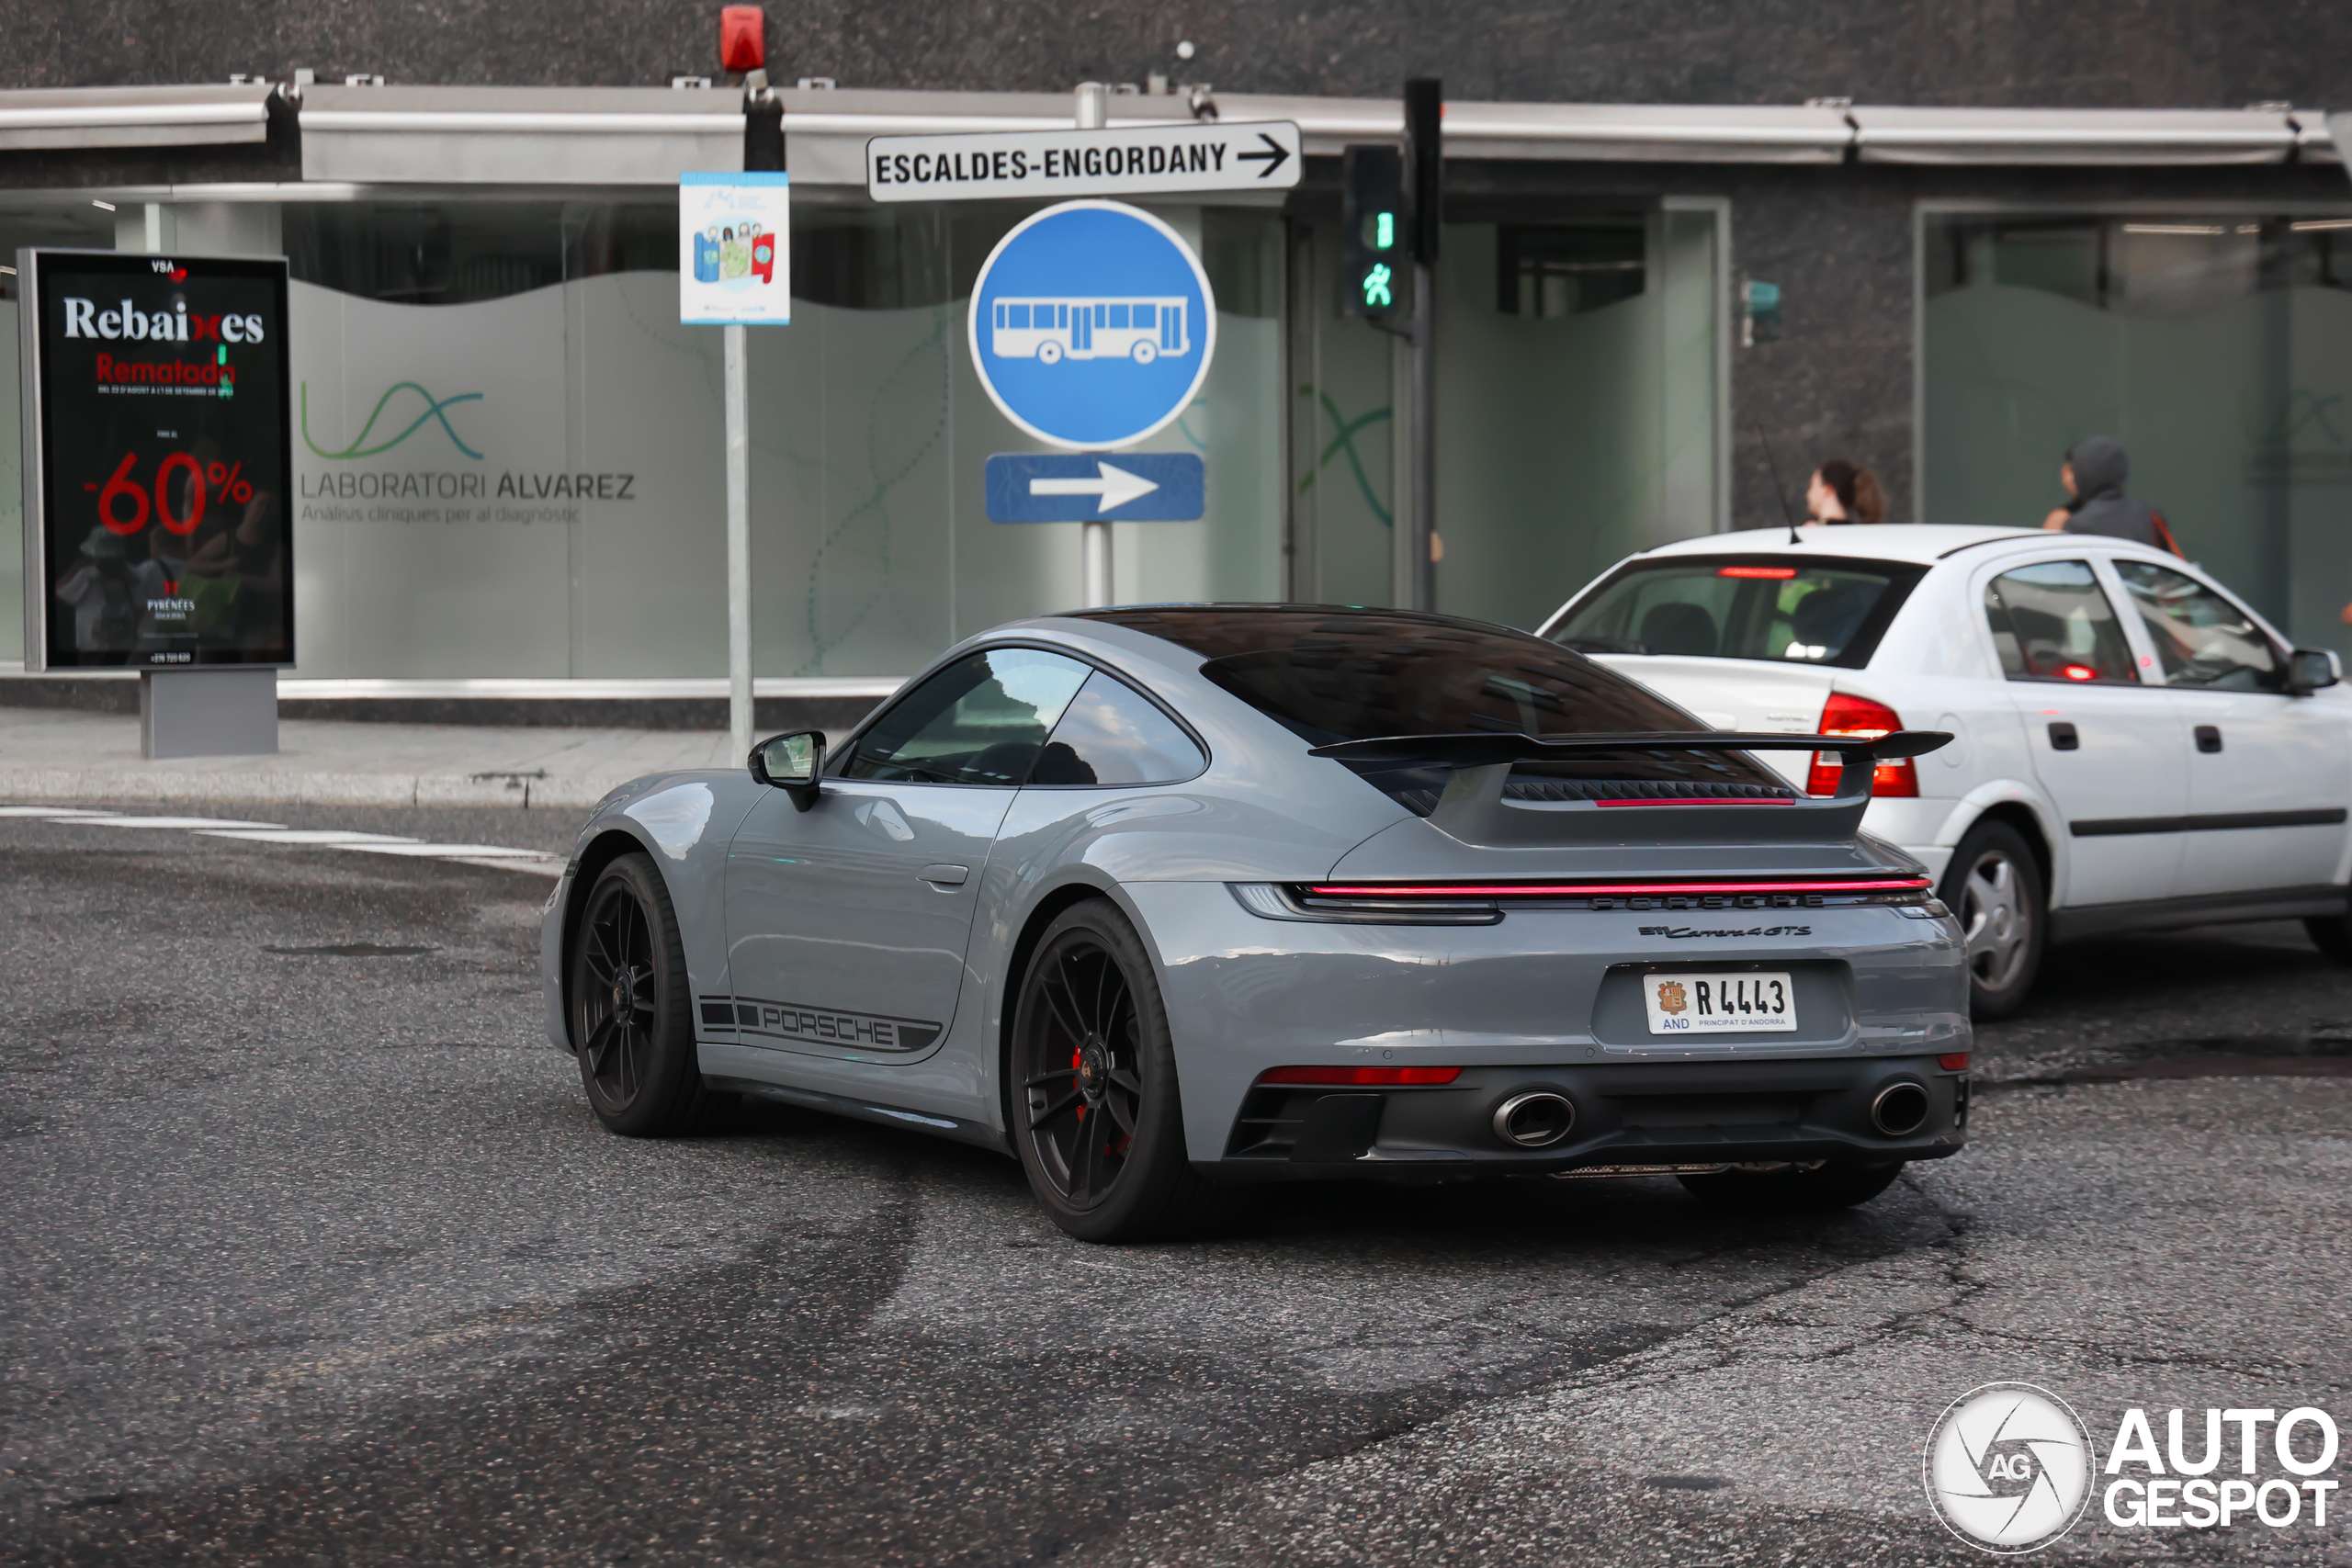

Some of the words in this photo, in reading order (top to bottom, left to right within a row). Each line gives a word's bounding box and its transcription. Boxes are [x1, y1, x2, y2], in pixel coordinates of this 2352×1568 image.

[876, 142, 1227, 184] ESCALDES-ENGORDANY
[63, 297, 265, 344] Rebaixes
[301, 472, 485, 499] LABORATORI
[446, 508, 470, 525] per
[1589, 895, 1826, 911] PORSCHE
[1667, 927, 1746, 939] Carrera
[1763, 926, 1813, 936] GTS
[1695, 981, 1713, 1015] R
[1721, 980, 1785, 1014] 4443
[763, 1007, 894, 1046] PORSCHE
[1663, 1018, 1690, 1030] AND
[1699, 1019, 1739, 1027] PRINCIPAT
[1741, 1018, 1786, 1026] D'ANDORRA
